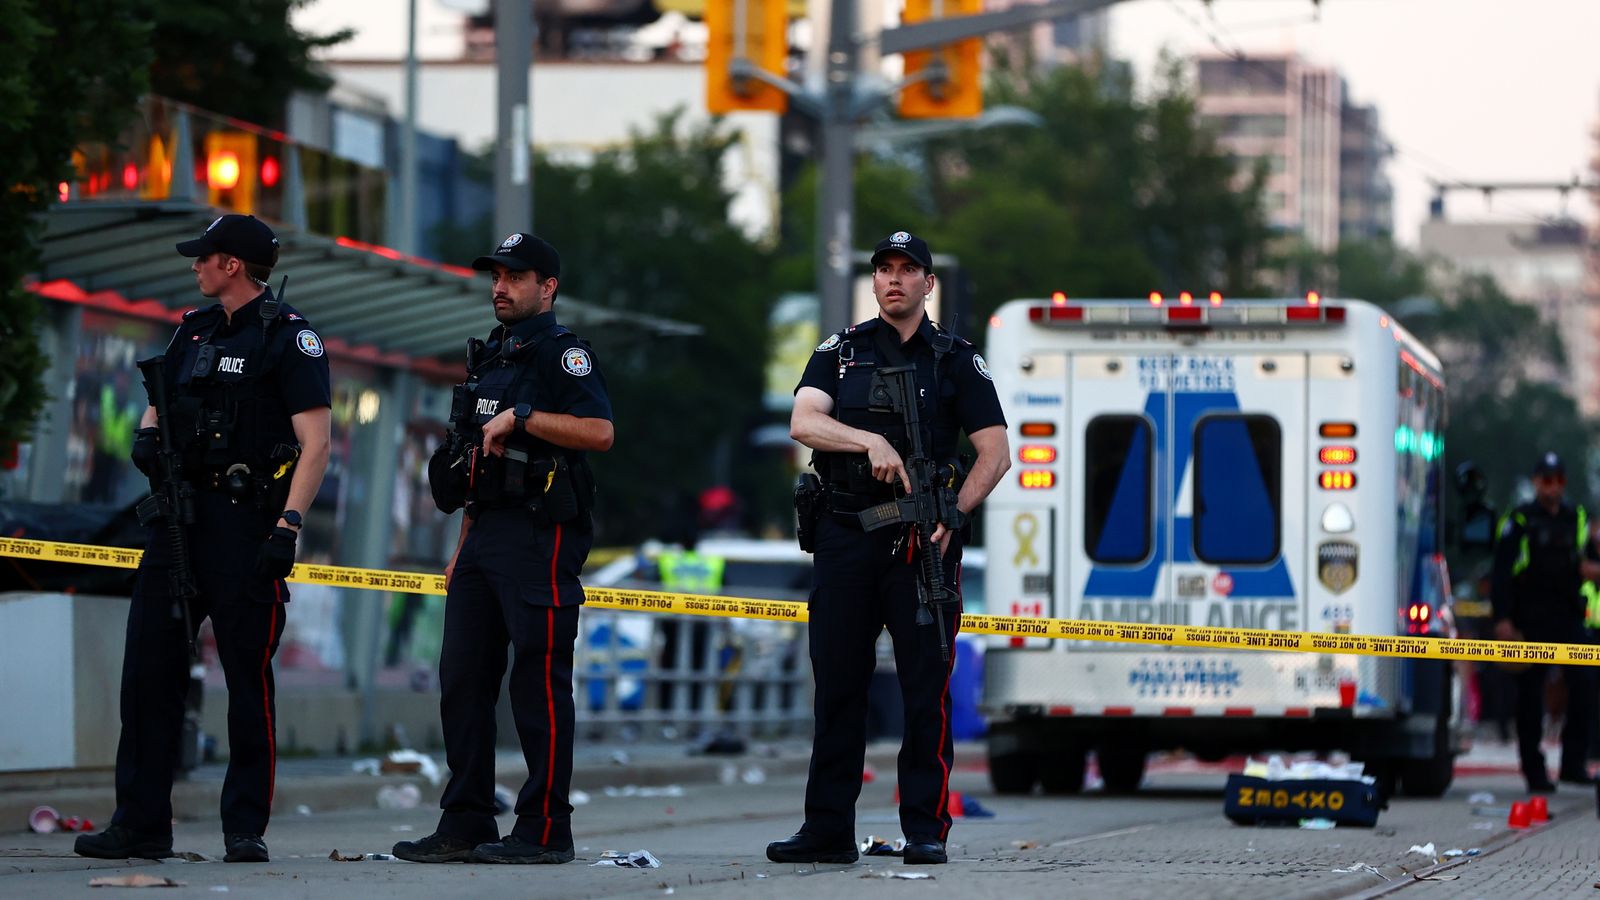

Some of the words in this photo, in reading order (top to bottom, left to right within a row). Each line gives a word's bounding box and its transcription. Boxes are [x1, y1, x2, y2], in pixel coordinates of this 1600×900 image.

[217, 356, 245, 374] POLICE
[475, 398, 499, 416] POLICE
[9, 544, 41, 555] POLICE
[616, 597, 638, 606] LINE-
[641, 599, 672, 608] POLICE
[686, 601, 709, 610] CROSS
[728, 604, 738, 612] DO
[741, 605, 764, 615] LINE-
[766, 607, 797, 617] POLICE
[992, 622, 1014, 632] LINE-
[1017, 624, 1047, 633] POLICE
[1060, 625, 1085, 634] CROSS
[1117, 629, 1139, 639] LINE-
[1142, 631, 1173, 641] POLICE
[1186, 633, 1211, 642] CROSS
[1213, 635, 1227, 643] NOT
[1242, 636, 1265, 646] LINE-
[1268, 638, 1299, 648] POLICE
[1313, 640, 1337, 648] CROSS
[1340, 641, 1354, 649] NOT
[1356, 642, 1367, 650] DO
[1369, 643, 1392, 652] LINE-
[1395, 644, 1426, 654] POLICE
[1440, 646, 1464, 654] CROSS
[1484, 648, 1495, 656] DO
[1497, 649, 1520, 658] LINE-
[1523, 650, 1555, 659] POLICE
[1568, 652, 1593, 660] CROSS
[1238, 787, 1344, 810] OXYGEN
